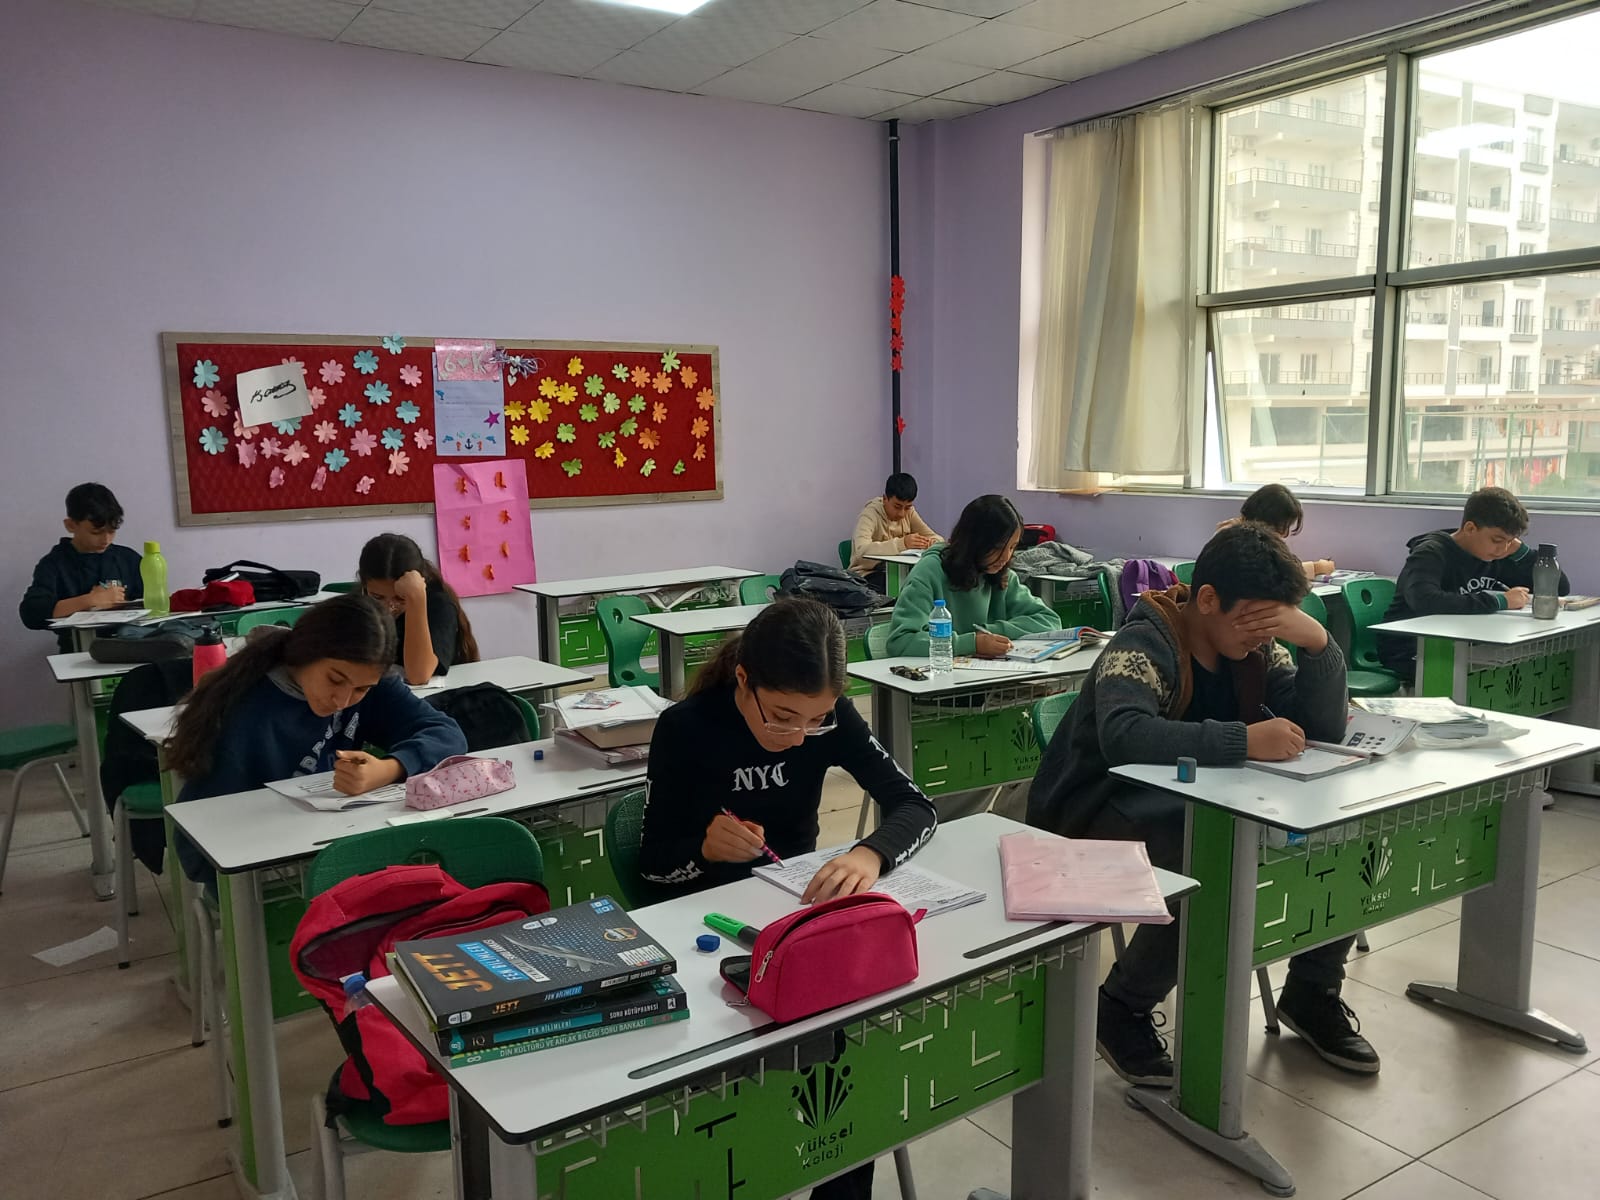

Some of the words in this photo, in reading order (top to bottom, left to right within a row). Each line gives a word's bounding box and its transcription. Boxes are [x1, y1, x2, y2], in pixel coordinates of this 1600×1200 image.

[731, 761, 790, 791] NYC
[409, 952, 494, 993] JETT
[492, 1000, 520, 1014] JETT
[472, 1035, 485, 1047] IQ
[609, 1010, 624, 1019] SORU
[500, 1047, 514, 1057] DİN
[600, 1025, 618, 1035] SORU
[794, 1121, 853, 1157] Yüksel
[802, 1143, 844, 1170] Koleji
